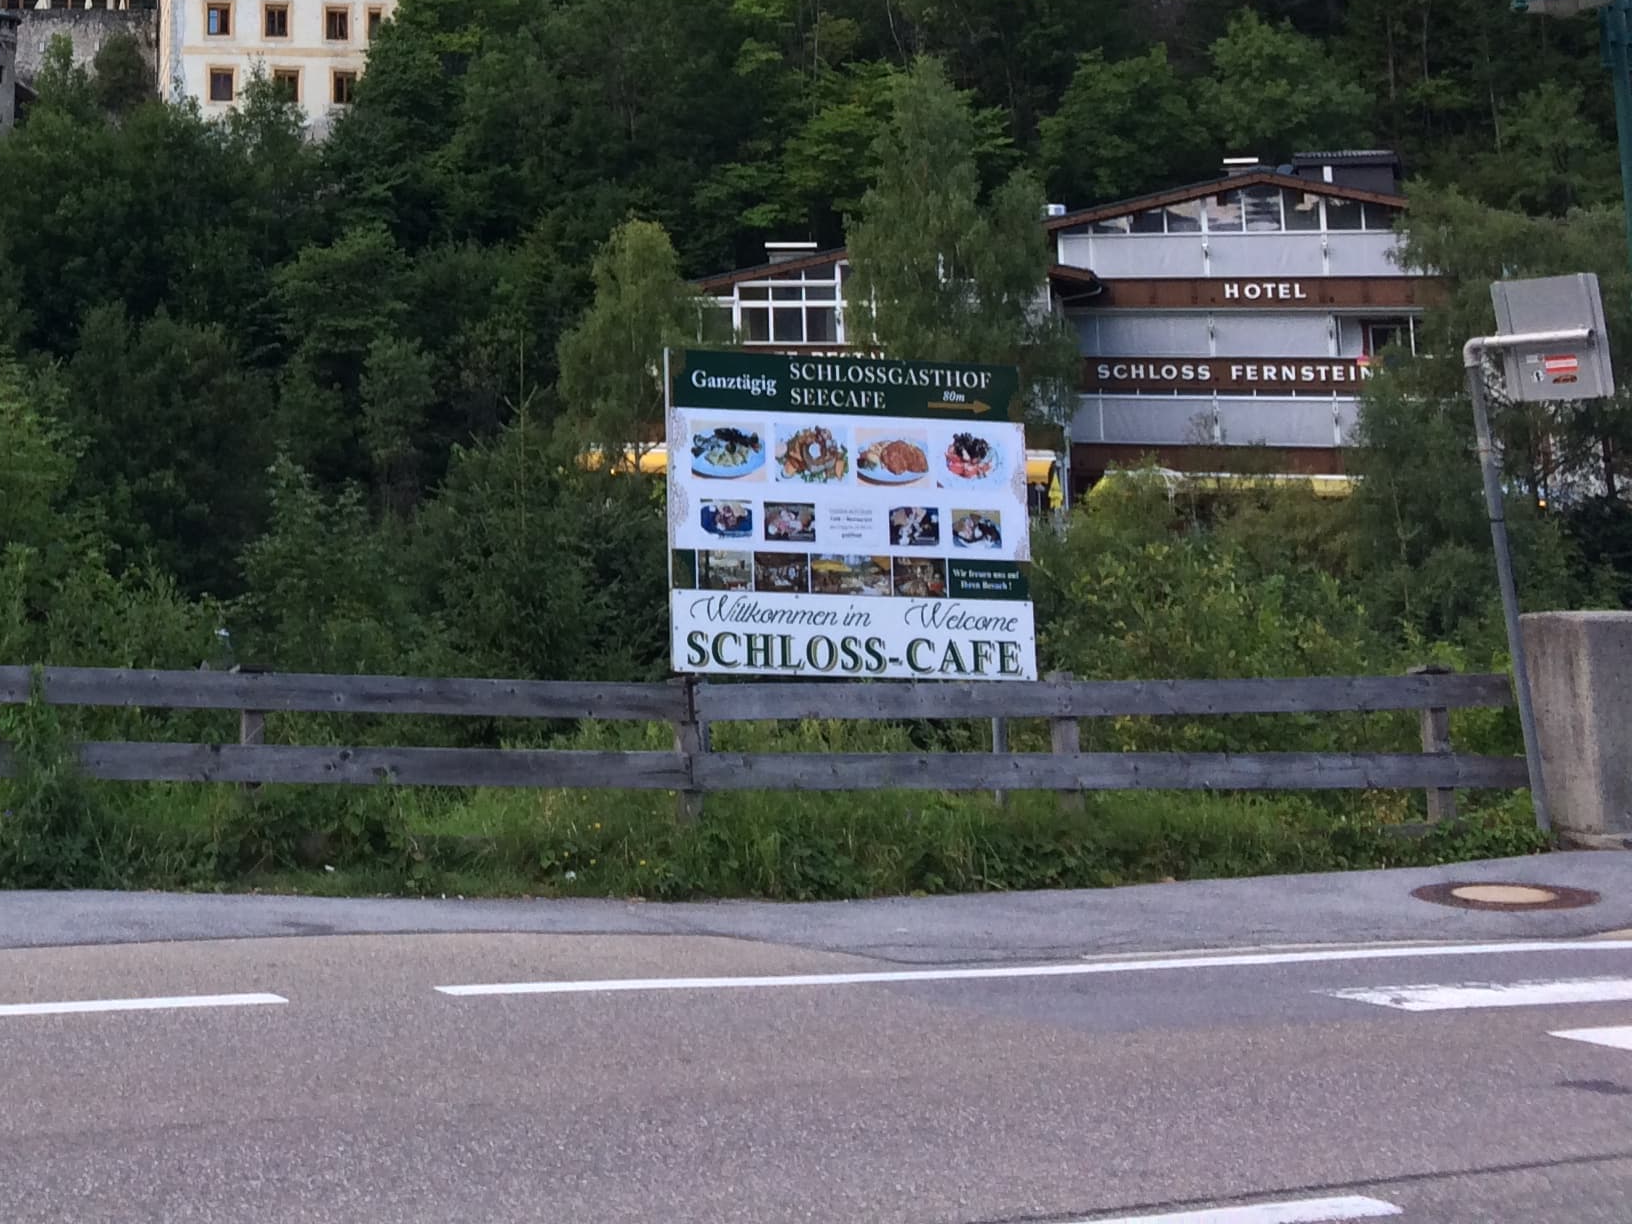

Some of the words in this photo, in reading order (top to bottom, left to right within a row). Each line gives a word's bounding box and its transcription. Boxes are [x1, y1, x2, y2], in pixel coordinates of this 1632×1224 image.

[1224, 283, 1307, 299] HOTEL
[691, 369, 777, 396] Ganztägig
[790, 362, 992, 389] SCHLOSSGASTHOF
[1097, 364, 1211, 380] SCHLOSS
[790, 387, 887, 410] SEECAFE
[942, 390, 965, 403] 80m
[689, 594, 838, 626] Willkommen
[843, 604, 872, 627] im
[904, 601, 1019, 633] Welcome
[686, 629, 1024, 677] SCHLOSS-CAFE
